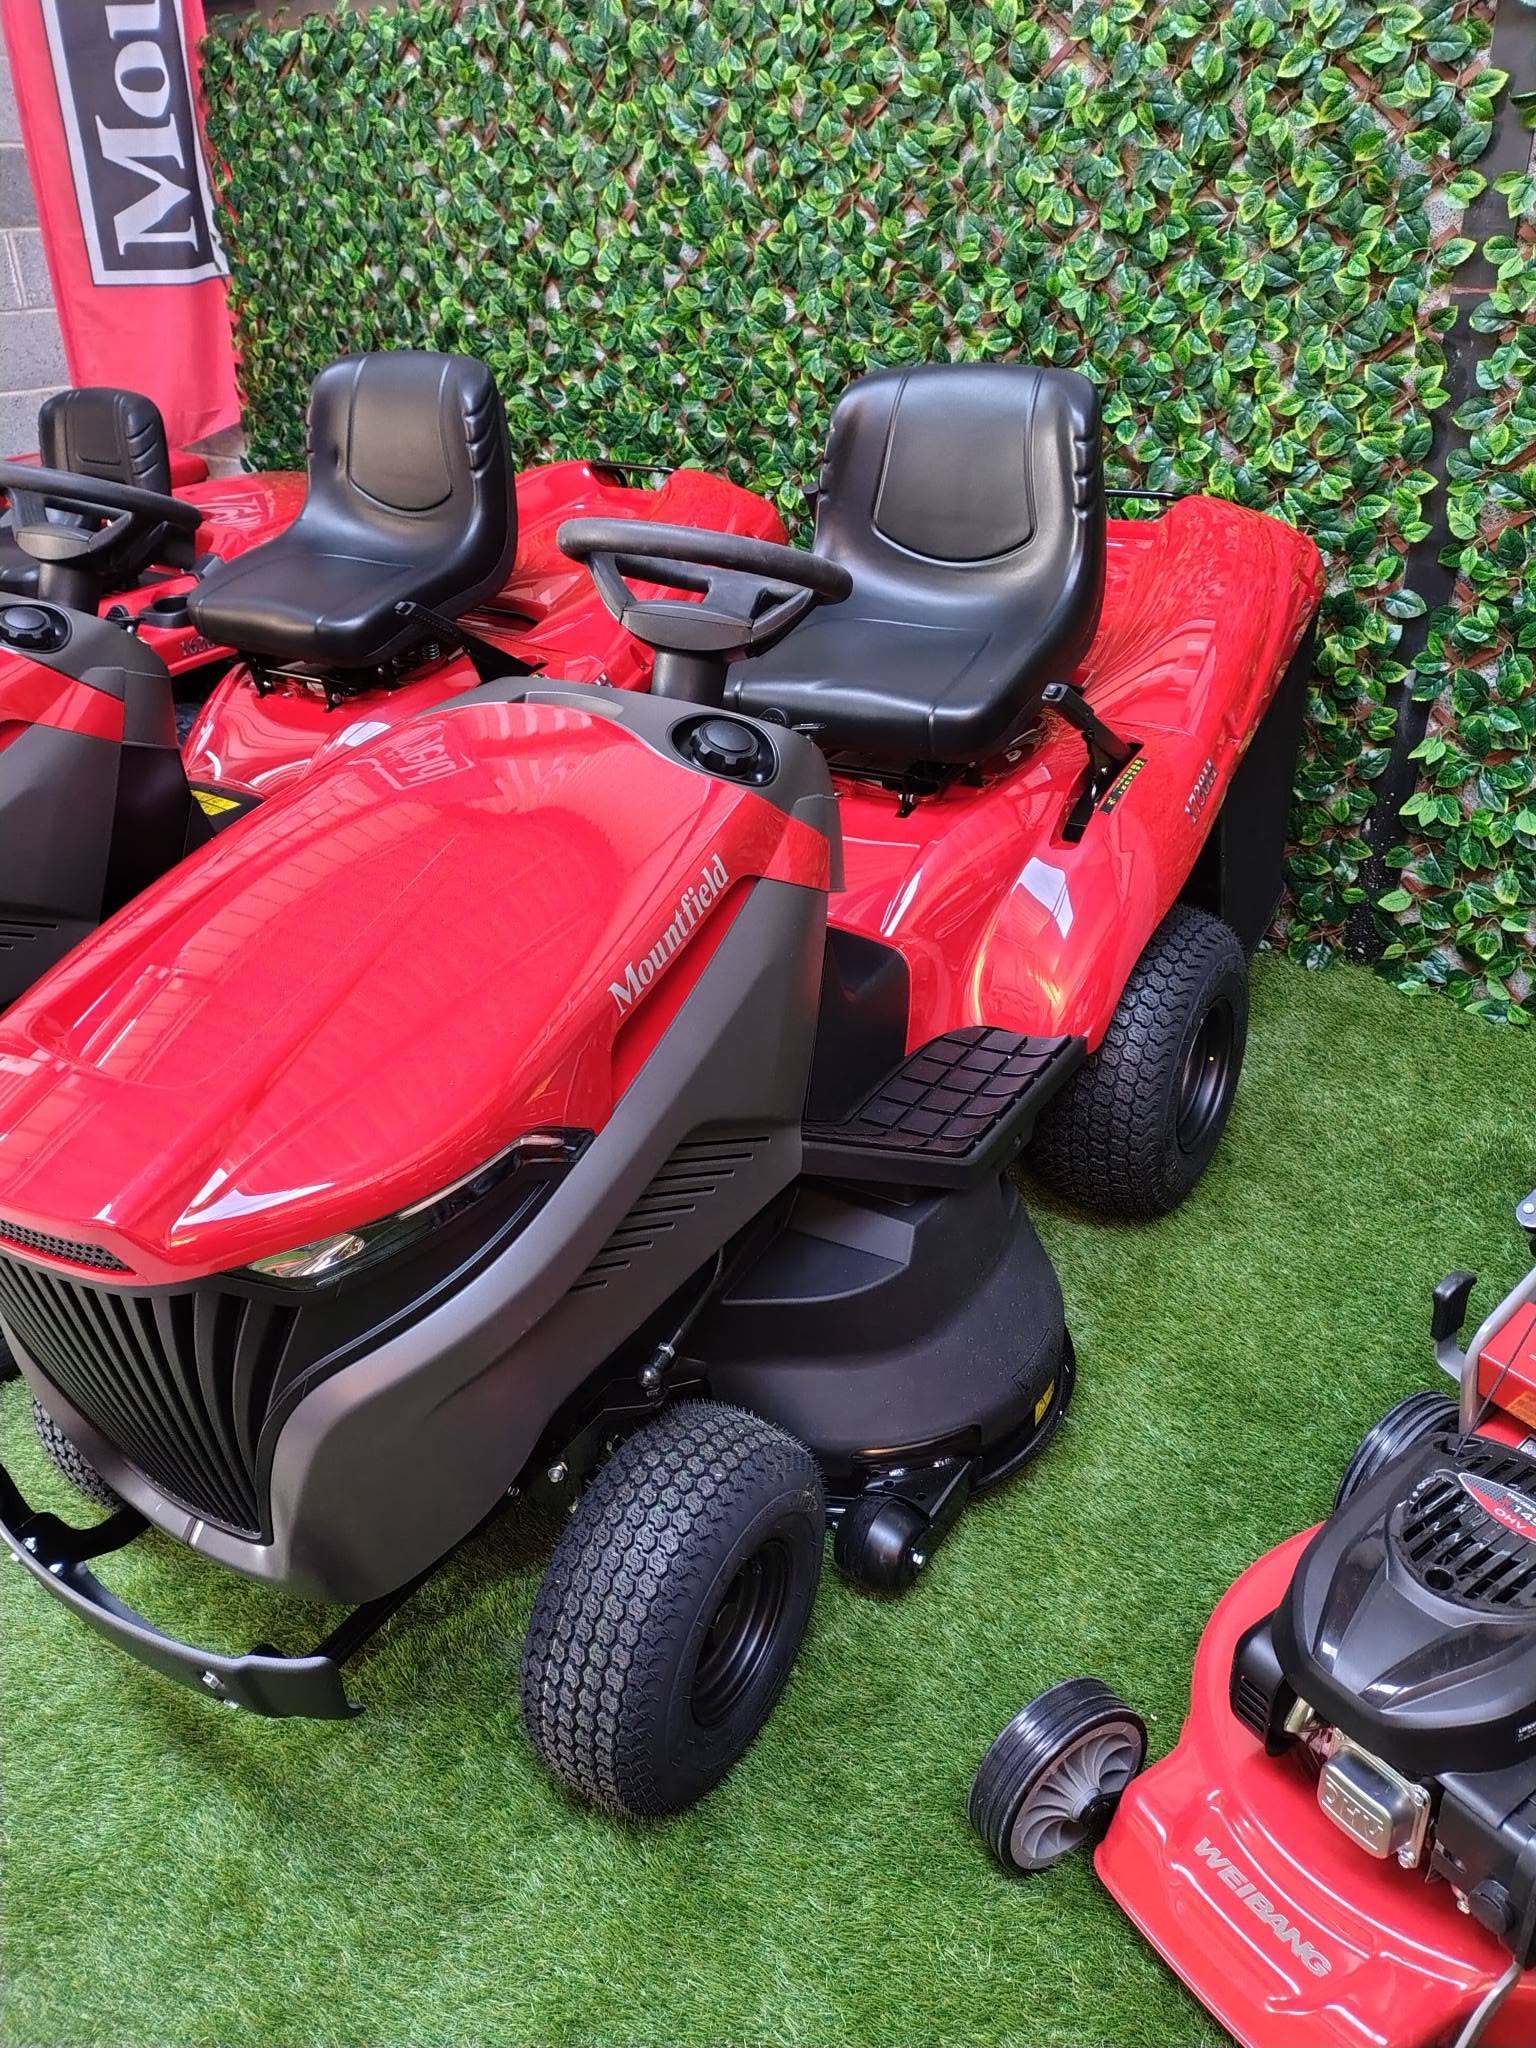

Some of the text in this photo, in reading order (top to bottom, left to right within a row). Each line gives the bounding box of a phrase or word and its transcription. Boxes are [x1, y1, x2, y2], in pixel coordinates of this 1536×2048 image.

[607, 852, 730, 1017] Mountfield
[1494, 1507, 1527, 1529] OHV
[1193, 1837, 1332, 1978] WEIBANG
